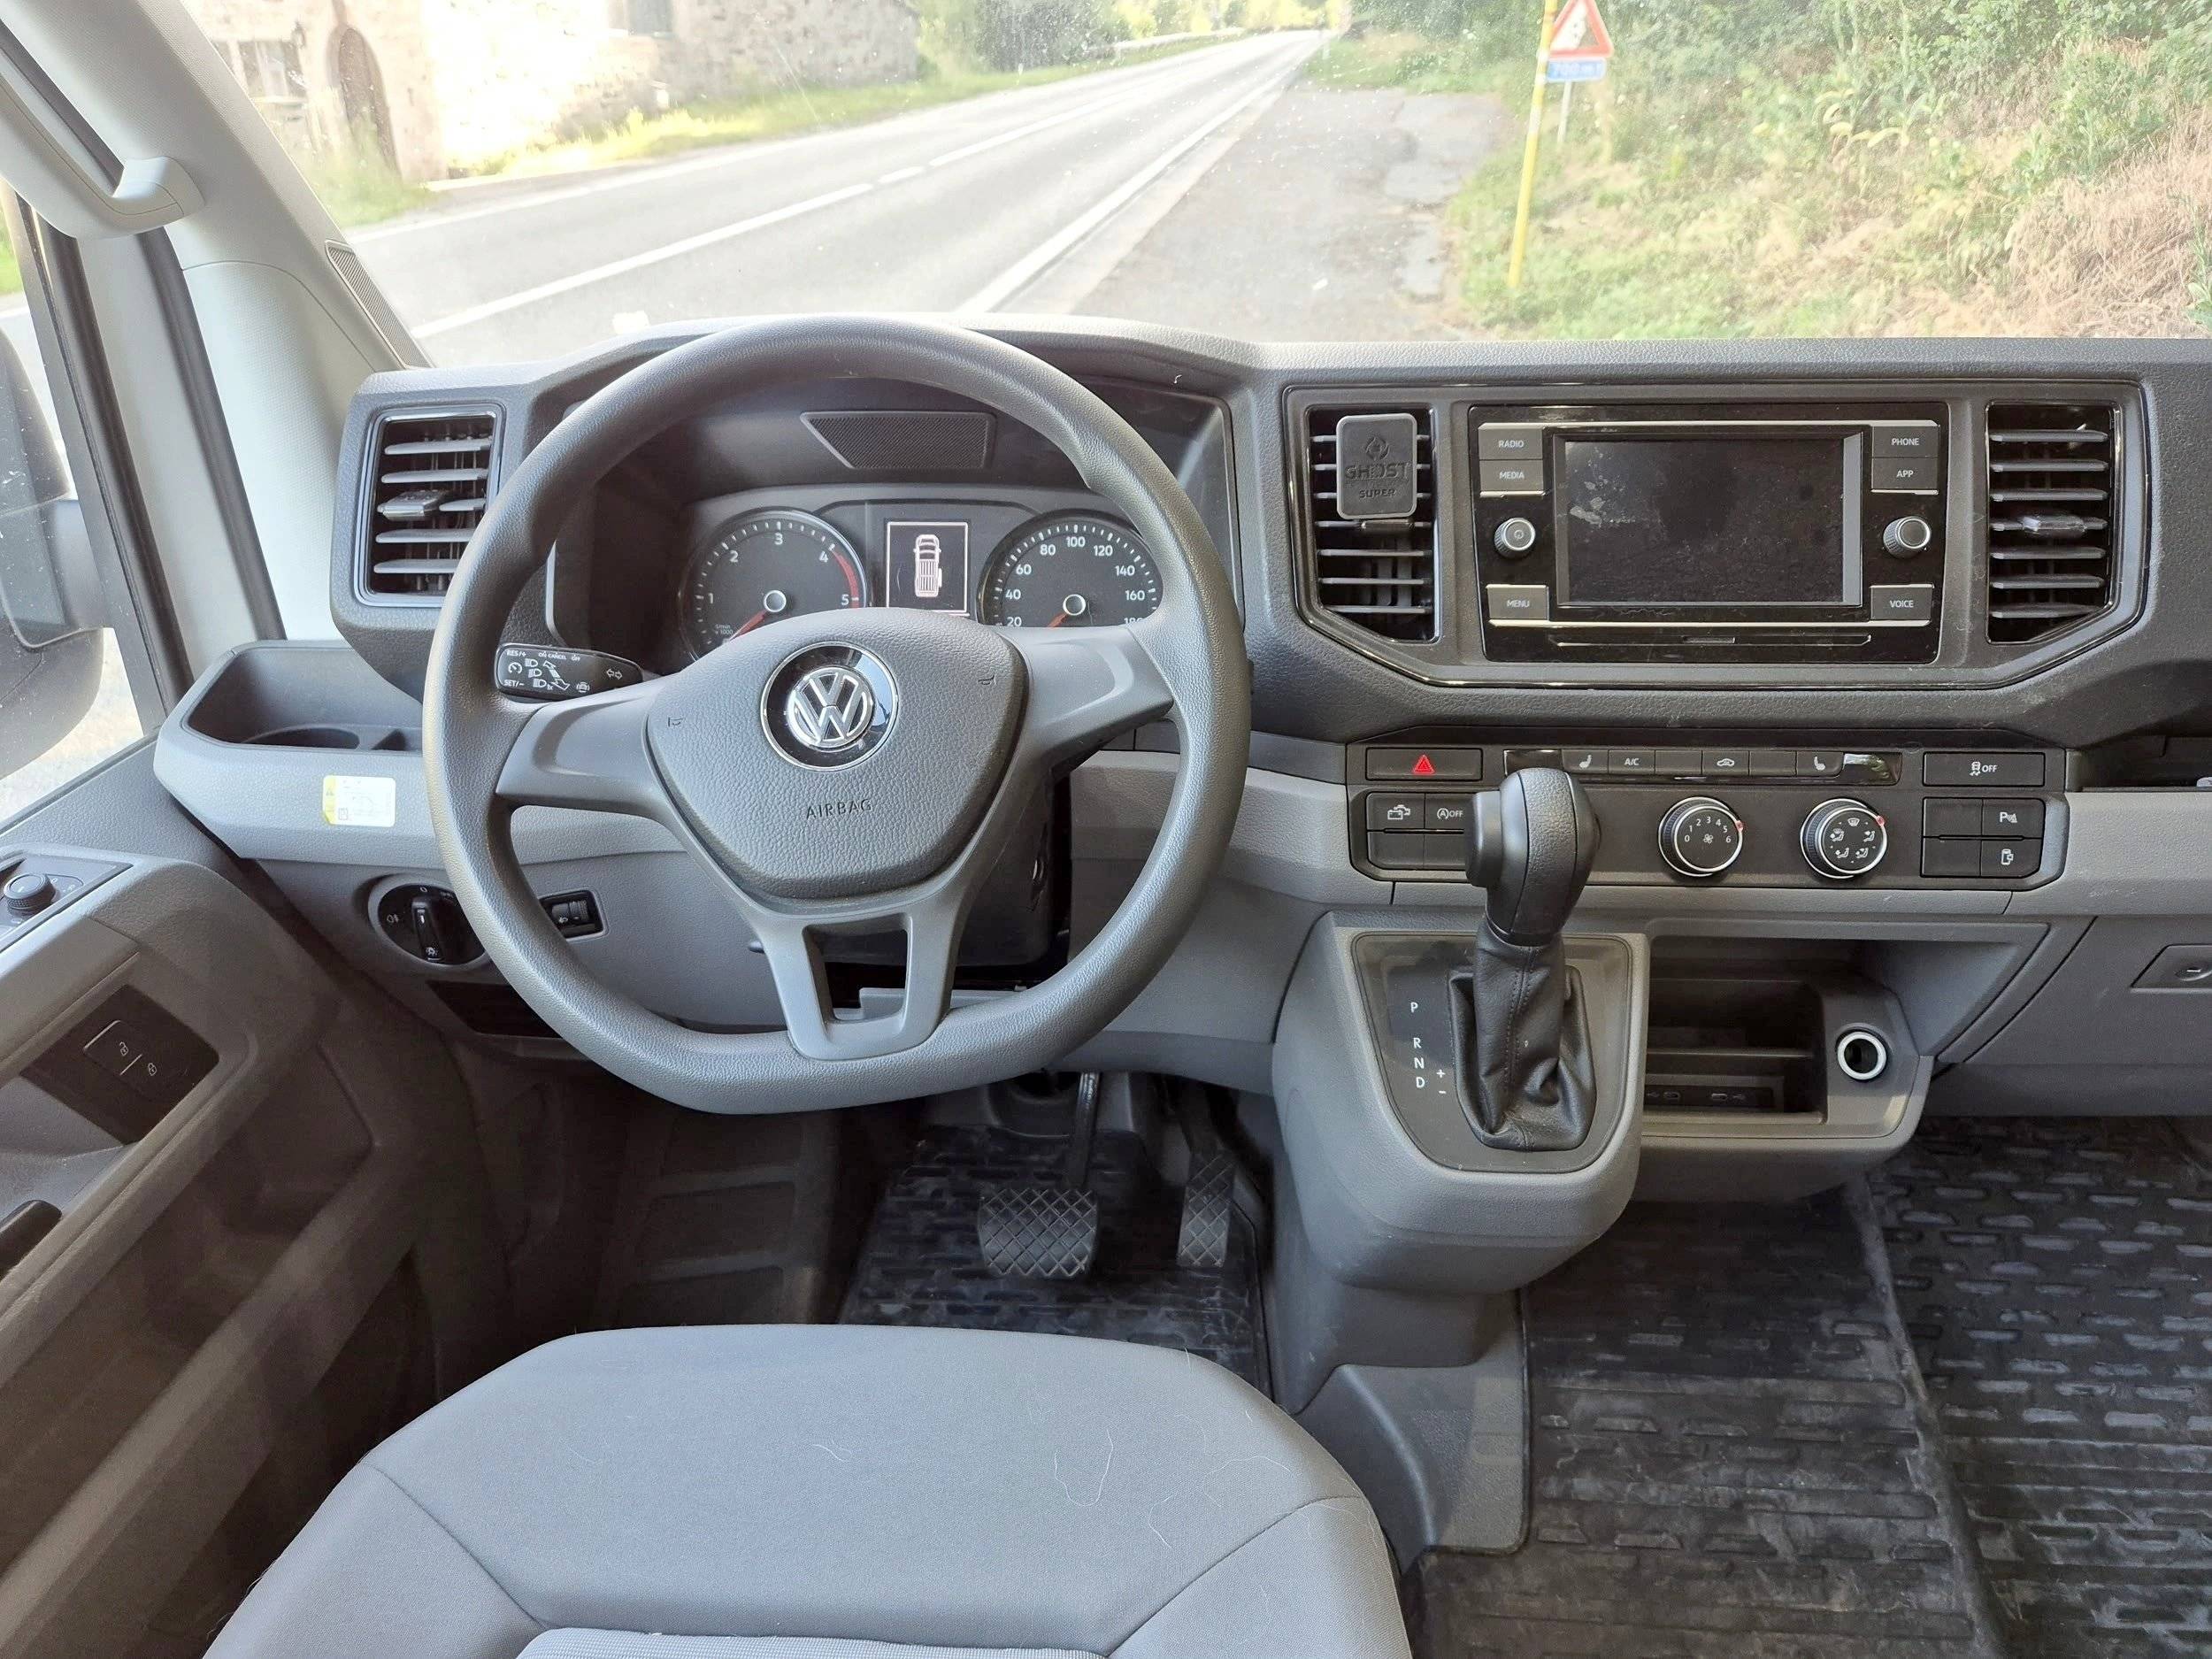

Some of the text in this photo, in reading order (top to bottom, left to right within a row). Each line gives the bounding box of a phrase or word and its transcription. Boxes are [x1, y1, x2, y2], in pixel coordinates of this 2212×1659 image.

[1498, 439, 1524, 449] RADIO
[1891, 437, 1919, 446] PHONE
[1499, 471, 1525, 480] MEDIA
[1896, 470, 1914, 479] APP
[1359, 488, 1396, 498] SUPER
[773, 532, 783, 545] 3
[1066, 536, 1086, 548] 100
[1040, 544, 1056, 556] 80
[1094, 545, 1113, 557] 120
[729, 550, 739, 563] 2
[818, 551, 828, 563] 4
[1016, 564, 1032, 575] 60
[1115, 565, 1135, 576] 140
[708, 593, 714, 603] 1
[841, 594, 849, 606] 5
[1005, 589, 1021, 600] 40
[1125, 590, 1146, 601] 160
[1507, 599, 1530, 608] MENU
[1007, 617, 1022, 627] 20
[1624, 757, 1640, 766] A/C
[1982, 764, 1997, 773] OFF
[806, 799, 872, 820] AIRBAG
[2000, 811, 2008, 823] P
[1723, 825, 1728, 833] 5
[1410, 1002, 1418, 1013] P
[1413, 1037, 1422, 1049] R
[1414, 1056, 1425, 1070] N
[1436, 1069, 1446, 1079] +
[1416, 1076, 1425, 1089] D
